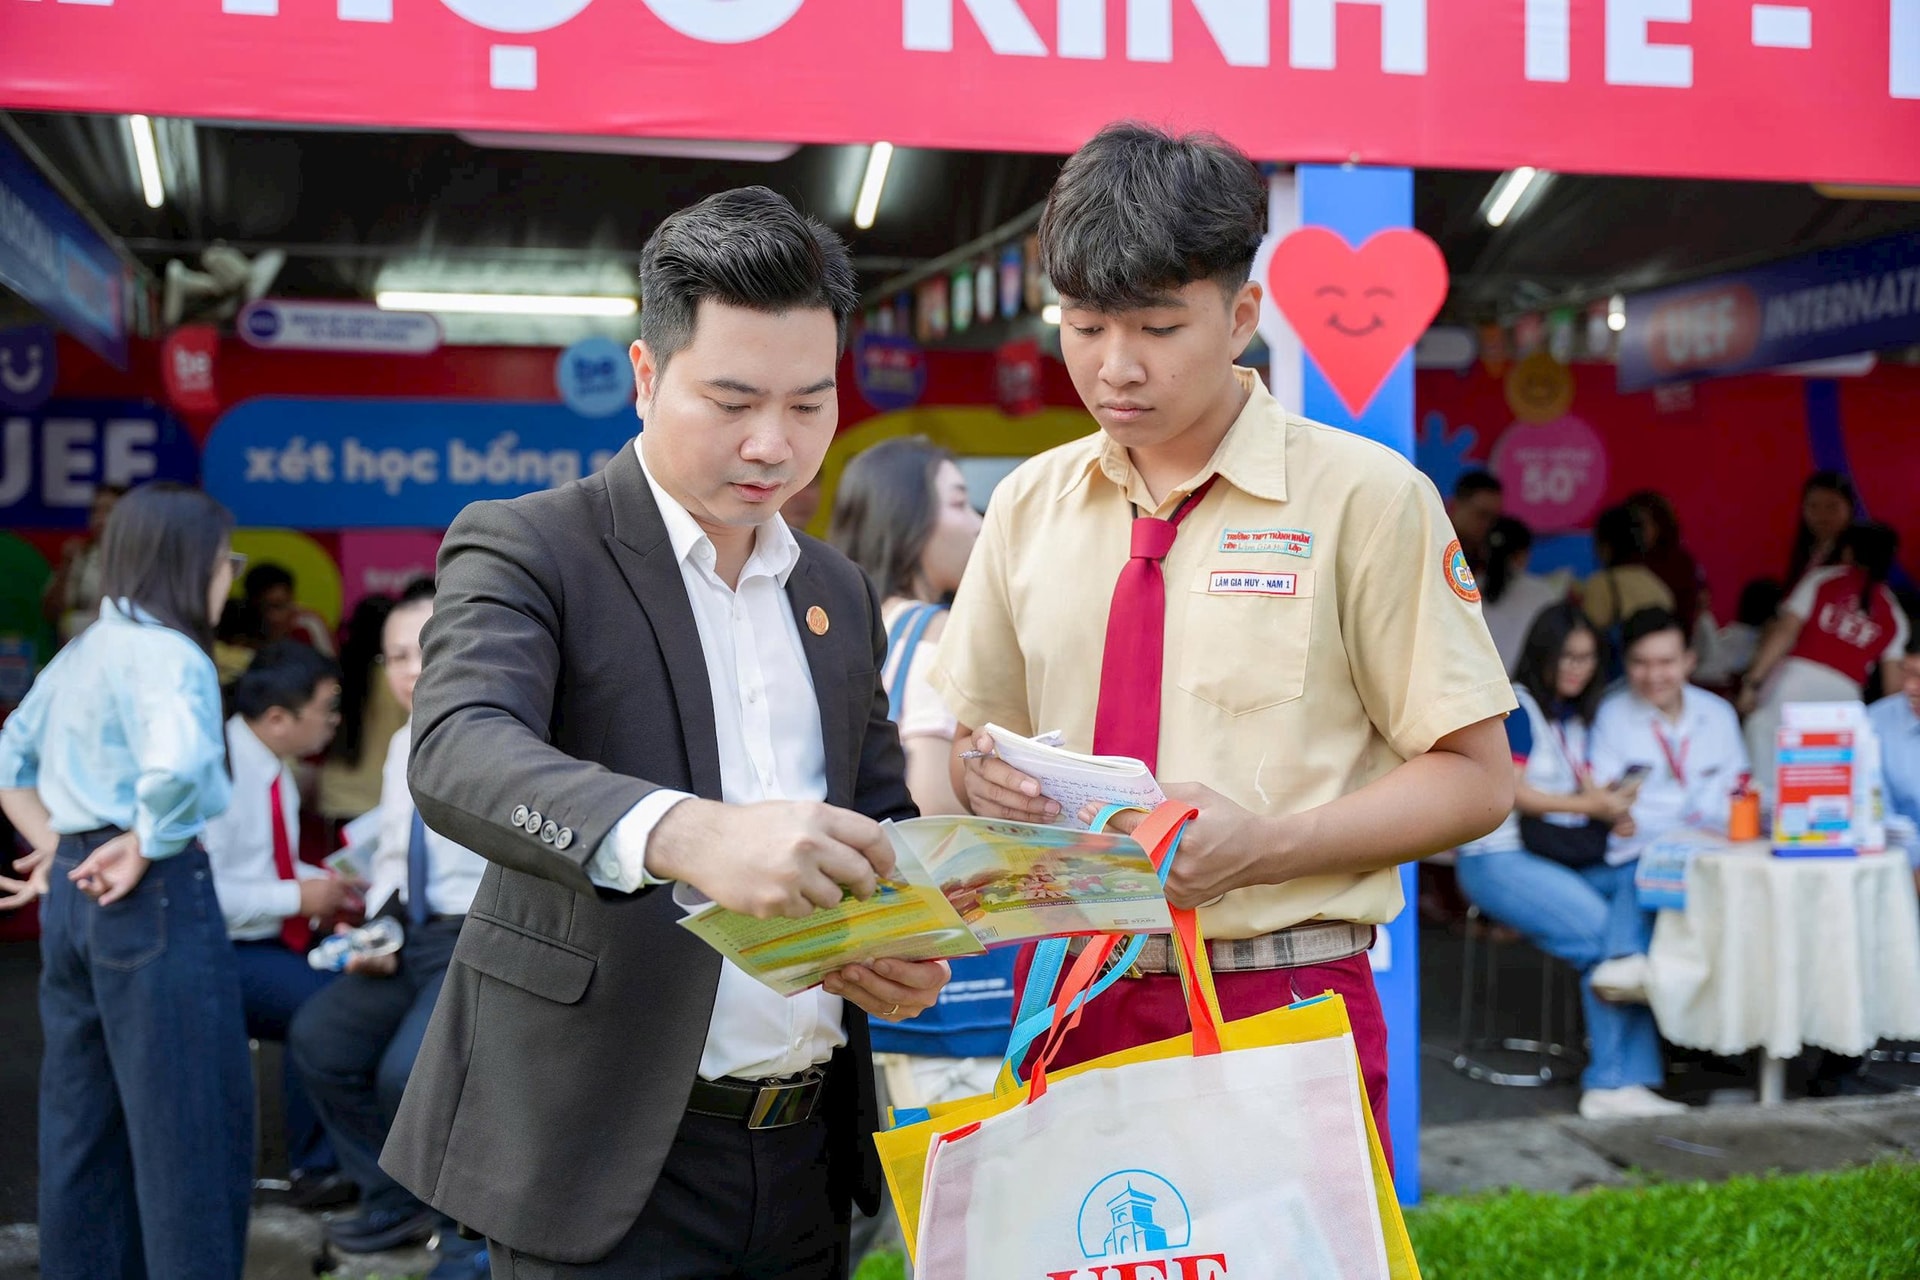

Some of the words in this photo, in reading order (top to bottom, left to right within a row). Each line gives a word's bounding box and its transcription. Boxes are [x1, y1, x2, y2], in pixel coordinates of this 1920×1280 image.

[244, 434, 333, 483] xét
[342, 436, 438, 497] học
[1230, 578, 1242, 587] GIA
[1244, 578, 1260, 587] HUY
[1266, 580, 1283, 589] NAM
